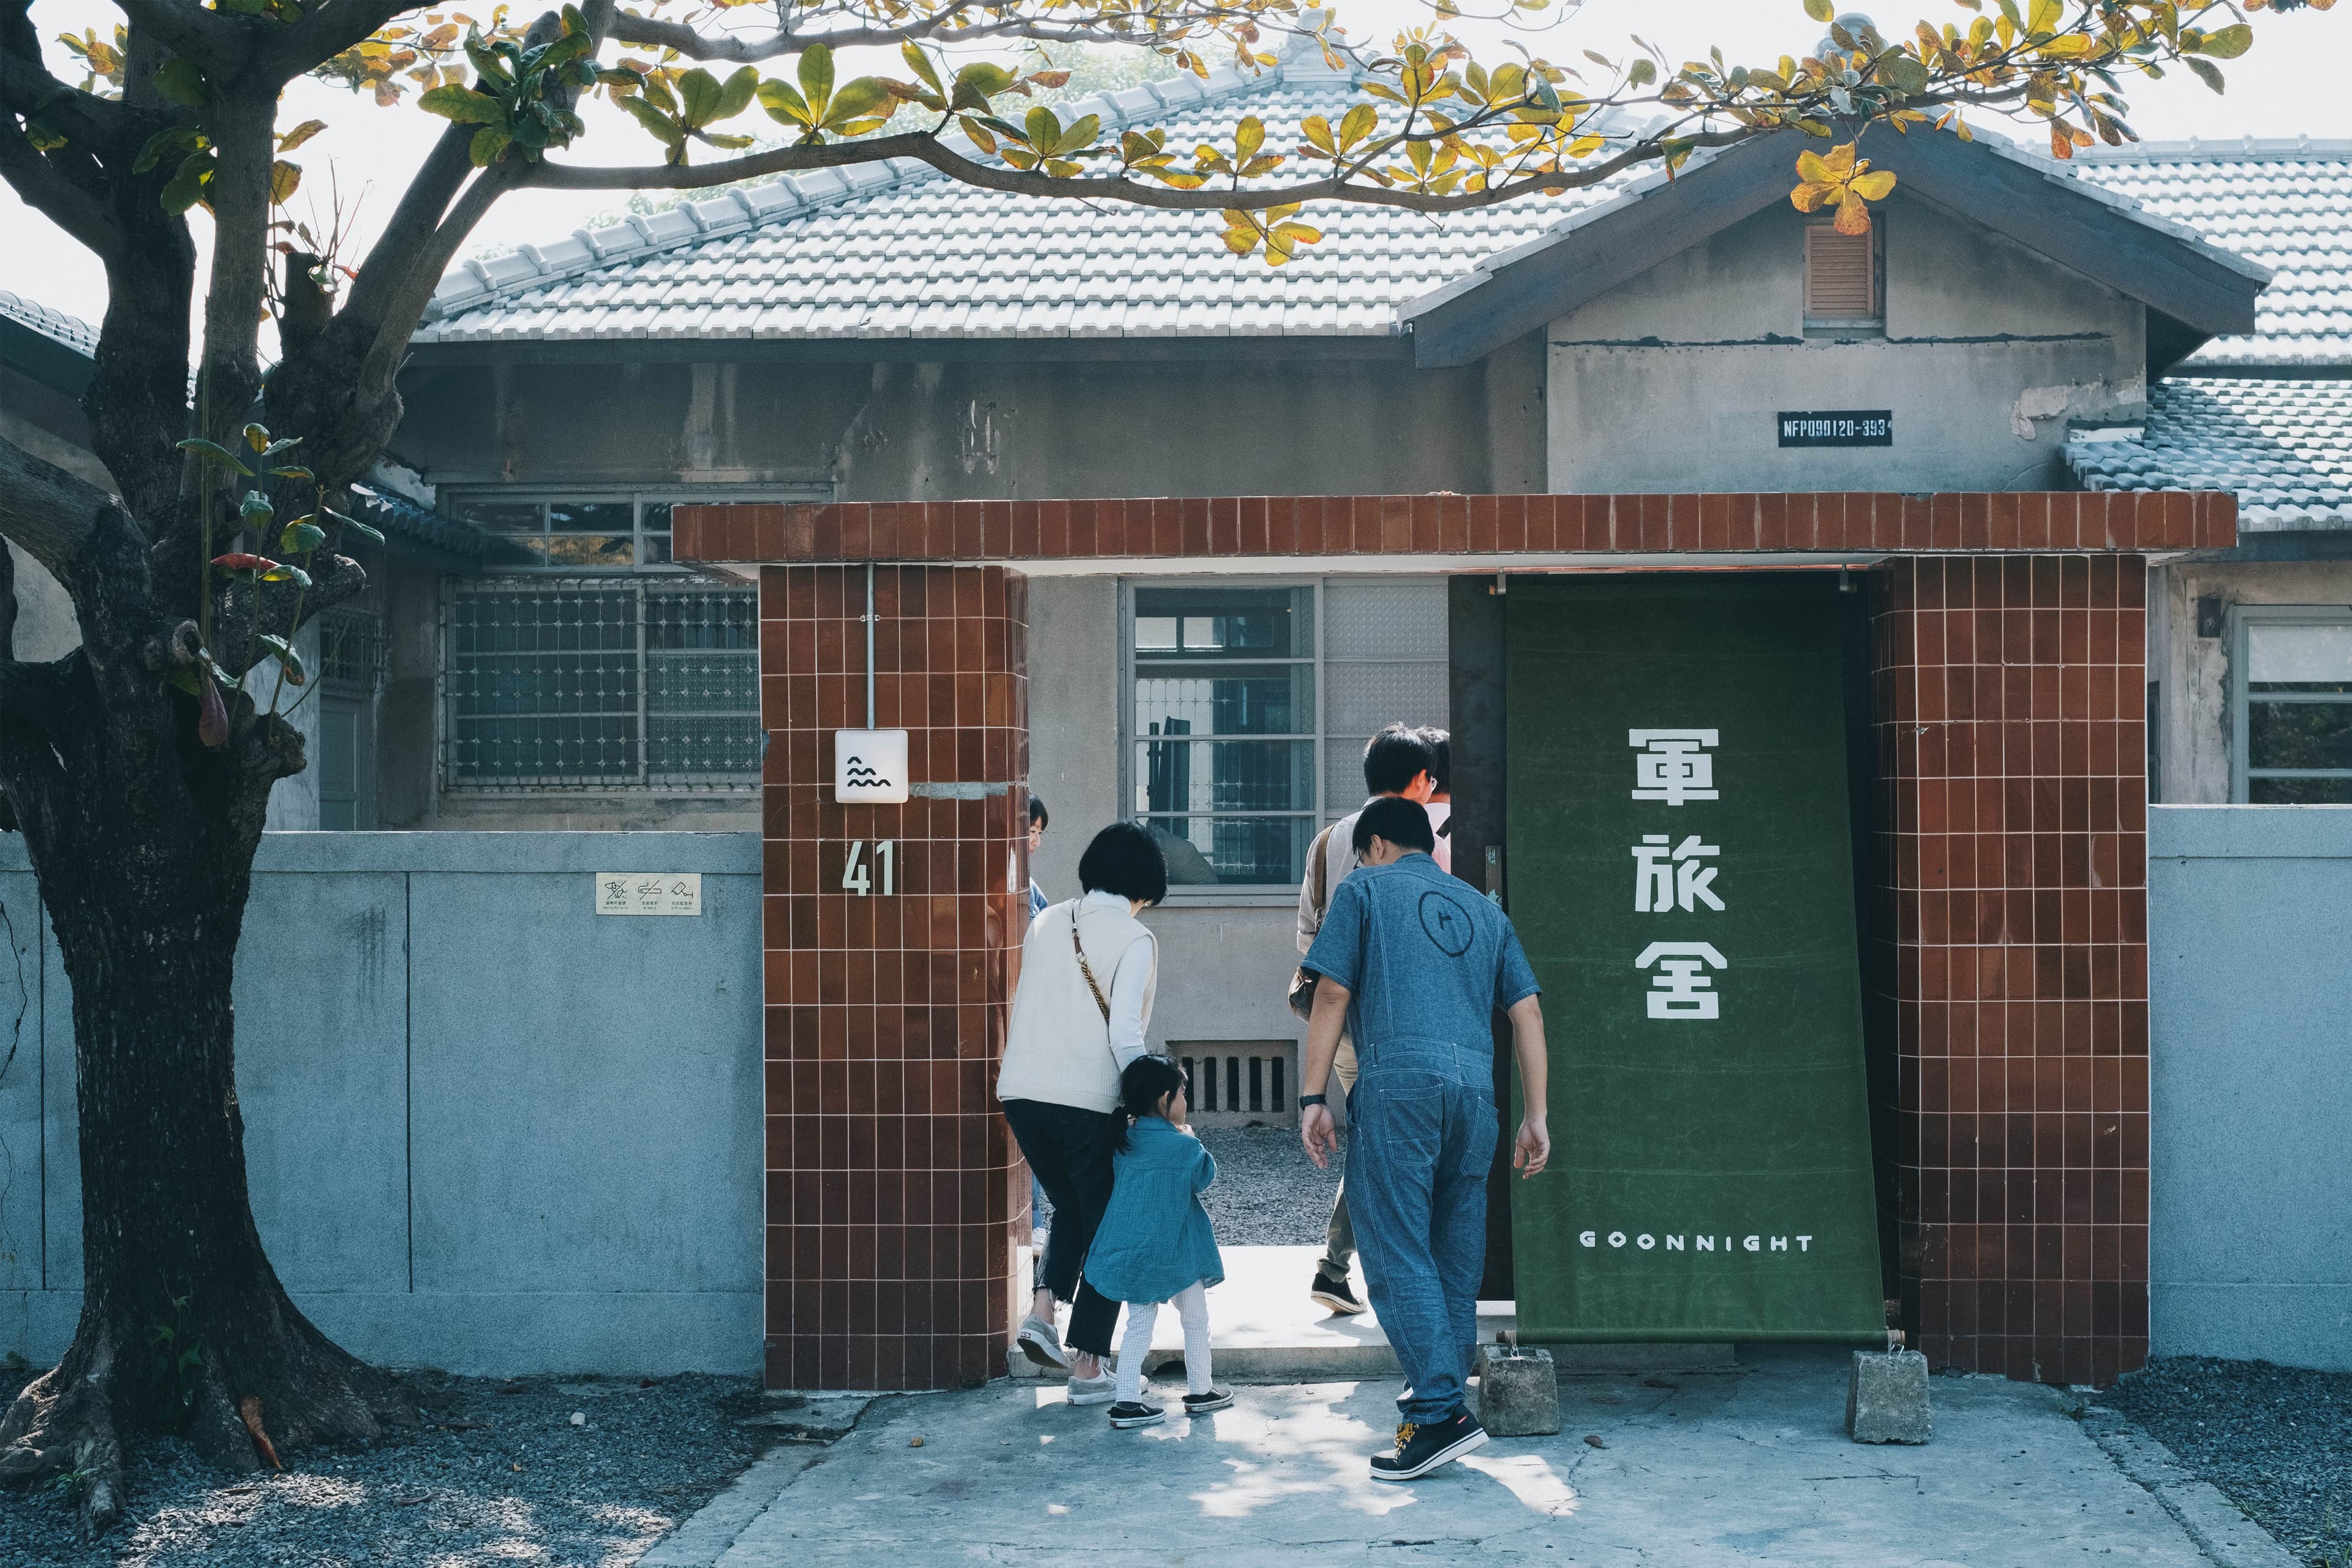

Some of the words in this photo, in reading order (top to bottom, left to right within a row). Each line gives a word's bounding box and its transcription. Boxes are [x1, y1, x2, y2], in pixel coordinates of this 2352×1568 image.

[843, 841, 893, 896] 41
[1629, 728, 1727, 1019] 軍旅舍
[1579, 1231, 1812, 1252] GOONNIGHT
